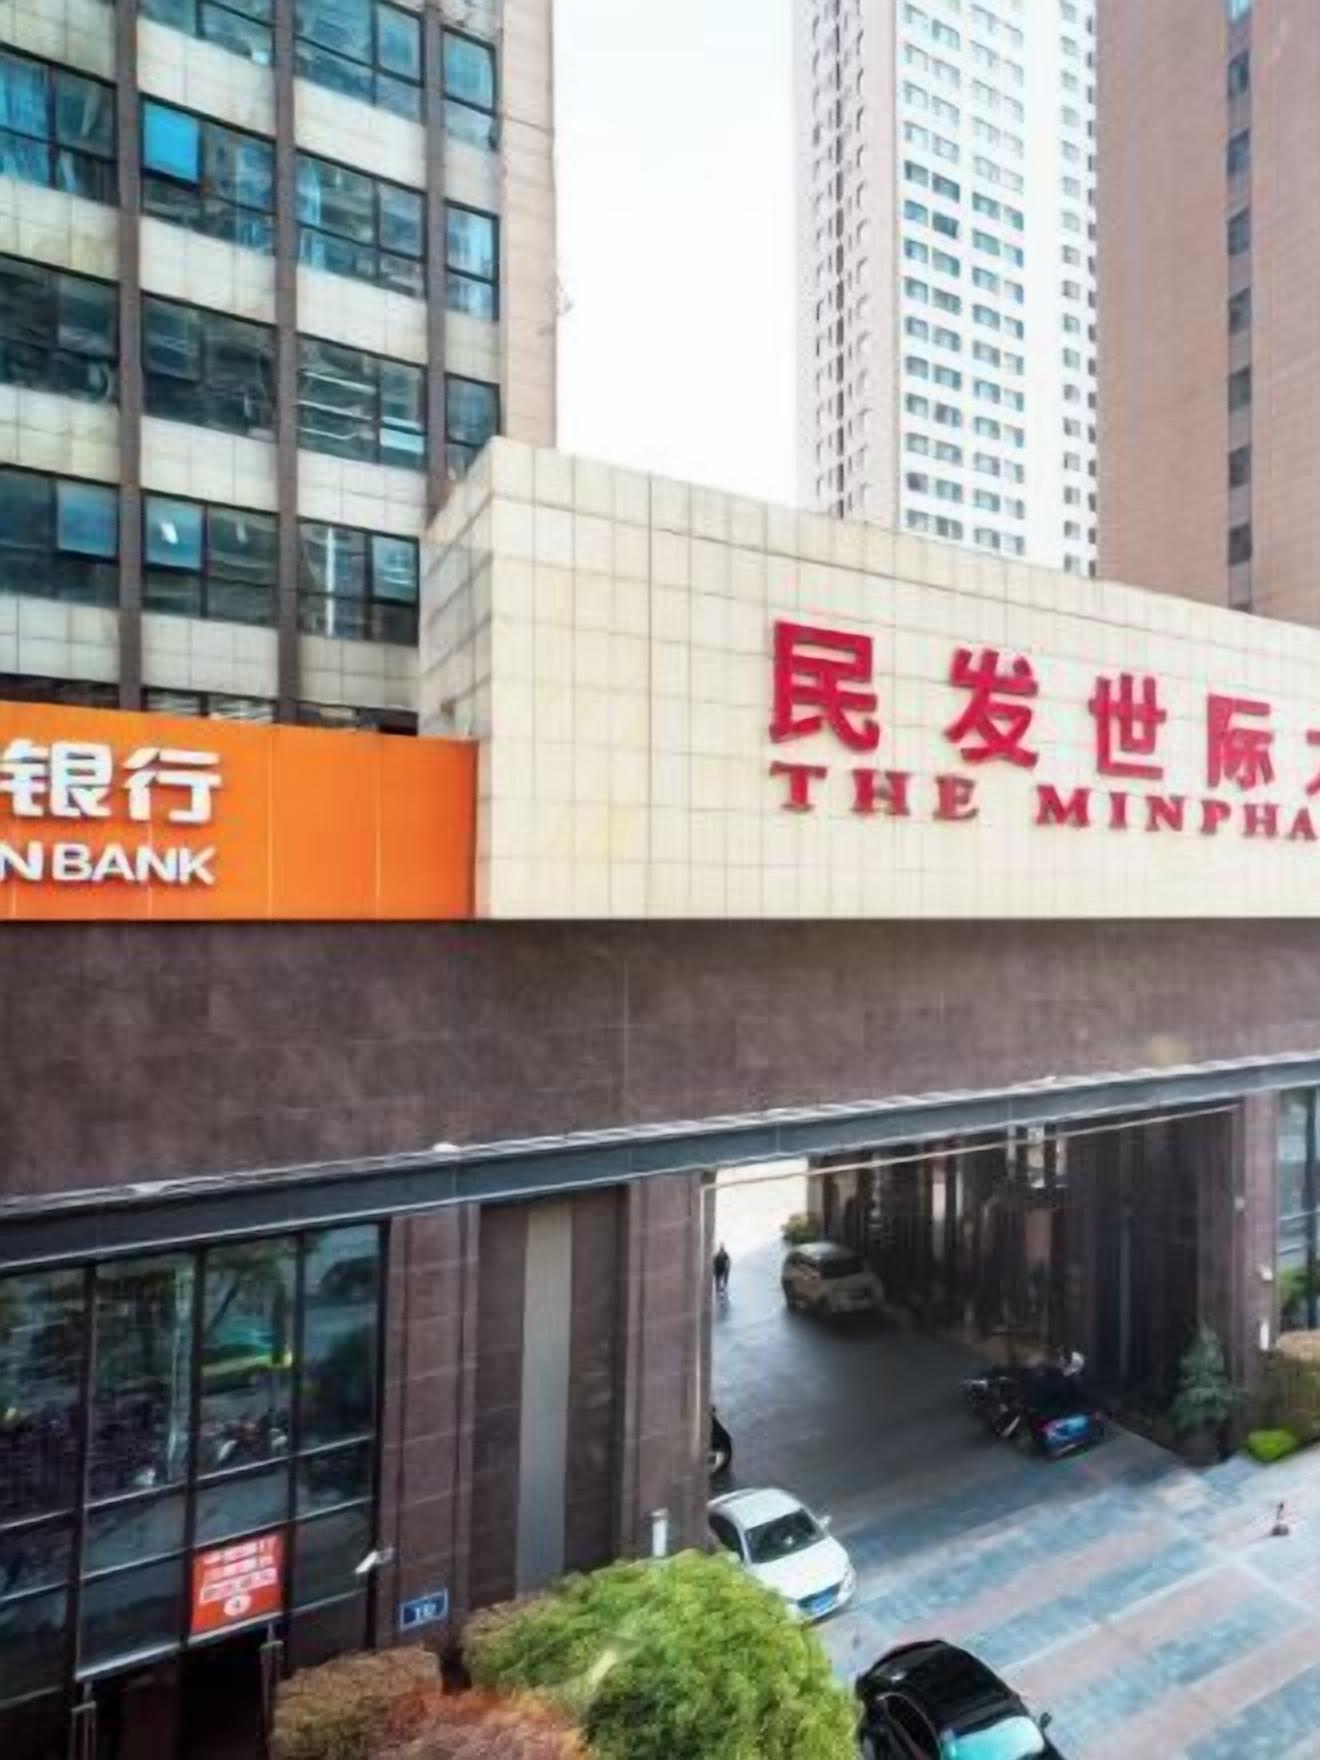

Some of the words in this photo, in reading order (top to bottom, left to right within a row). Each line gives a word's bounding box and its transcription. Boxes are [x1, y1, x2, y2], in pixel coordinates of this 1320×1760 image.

[0, 738, 223, 824] 银行
[769, 760, 979, 822] THE
[1035, 784, 1318, 841] MINPHA
[52, 843, 216, 886] BANK
